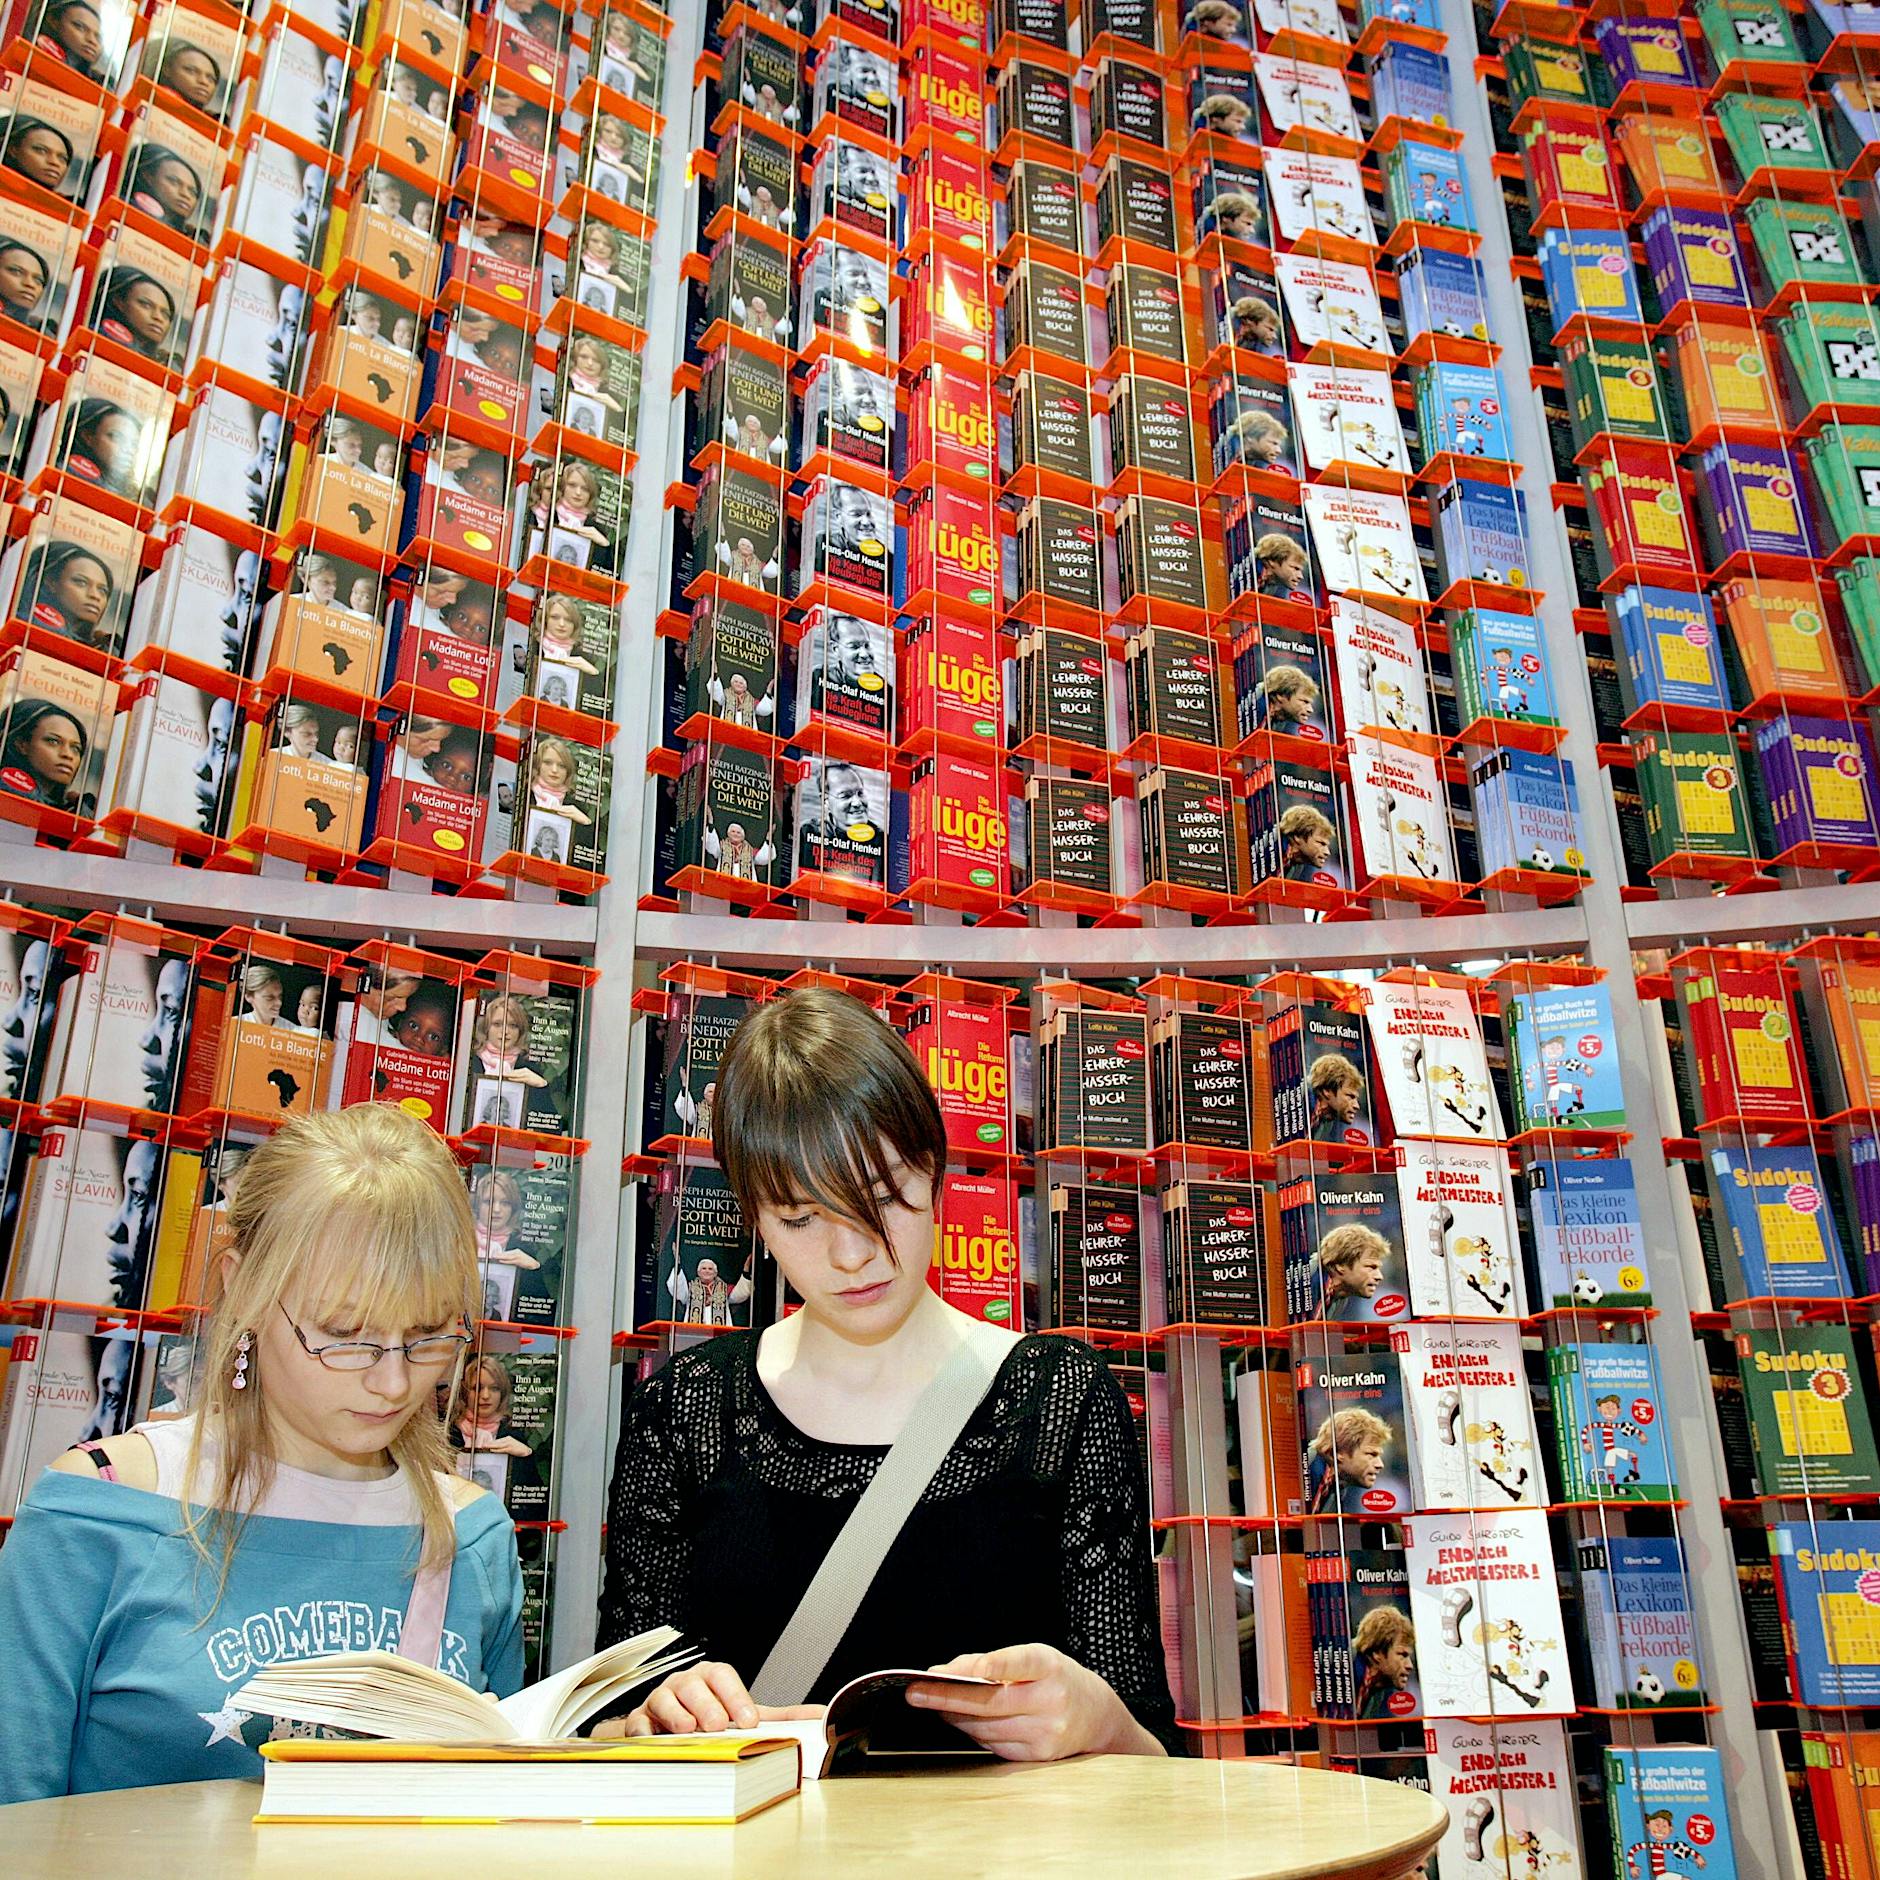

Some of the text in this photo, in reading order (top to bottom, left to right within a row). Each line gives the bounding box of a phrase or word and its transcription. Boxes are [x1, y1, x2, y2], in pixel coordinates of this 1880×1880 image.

[920, 73, 981, 119] lüge
[476, 256, 515, 276] Madame
[928, 396, 996, 447] lüge
[1257, 505, 1281, 519] Oliver
[1155, 524, 1170, 533] DAS
[1149, 535, 1189, 547] LEHRER-
[1151, 548, 1193, 560] HASSER-
[1159, 561, 1188, 572] BUCH
[23, 670, 110, 715] Feuerherz
[841, 695, 880, 715] Kraft des
[152, 716, 202, 742] SKLAVIN
[1659, 749, 1734, 768] Sudoku
[972, 769, 989, 780] Müller
[1373, 761, 1414, 781] ENDLICH
[1712, 769, 1726, 785] 3
[712, 780, 769, 802] GOTT UND
[1281, 774, 1330, 794] Oliver Kahn
[412, 791, 456, 812] Madame
[718, 791, 764, 811] DIE WELT
[978, 795, 989, 805] Die
[1184, 801, 1200, 809] DAS
[933, 795, 1006, 849] lüge
[1178, 812, 1221, 823] LEHRER-
[1180, 827, 1223, 839] HASSER-
[852, 842, 881, 856] Henkel
[1188, 843, 1219, 854] BUCH
[89, 992, 150, 1014] SKLAVIN
[947, 1009, 990, 1024] Albrecht Müller
[1394, 1008, 1445, 1021] ENDLICH
[1309, 1021, 1359, 1040] Oliver Kahn
[1771, 1018, 1784, 1036] 2
[240, 1031, 267, 1049] Lotti,
[271, 1038, 283, 1051] La
[978, 1042, 990, 1052] Die
[1087, 1045, 1105, 1055] DAS
[1200, 1047, 1217, 1057] DAS
[377, 1056, 450, 1081] Madame Lotti
[1193, 1060, 1239, 1073] LEHRER-
[928, 1047, 1006, 1103] lüge
[1194, 1077, 1242, 1090] HASSER-
[1089, 1091, 1125, 1106] BUCH
[1203, 1094, 1235, 1108] BUCH
[54, 1136, 63, 1155] Knaur
[547, 1155, 564, 1171] 20
[1426, 1171, 1480, 1185] ENDLICH
[1733, 1167, 1815, 1187] Sudoku
[54, 1178, 117, 1201] SKLAVIN
[951, 1183, 996, 1194] Albrecht Müller
[527, 1192, 552, 1202] Ihm in
[673, 1196, 730, 1211] BENEDIKT
[1320, 1190, 1384, 1205] Oliver Kahn
[1582, 1195, 1626, 1208] kleine
[524, 1210, 546, 1219] sehen
[525, 1201, 564, 1213] die Augen
[1326, 1206, 1381, 1216] Nummer eins
[680, 1210, 743, 1226] GOTT UND
[983, 1215, 996, 1225] Die
[1209, 1218, 1226, 1228] DAS
[1553, 1208, 1627, 1225] Lexikon
[686, 1223, 740, 1238] DIE WELT
[1202, 1230, 1251, 1246] LEHRER-
[1556, 1227, 1634, 1246] Fußball-
[932, 1224, 1016, 1281] lüge
[1204, 1247, 1254, 1263] HASSER-
[1560, 1248, 1634, 1265] rekorde
[1213, 1265, 1247, 1281] BUCH
[1213, 1291, 1227, 1299] Mutter
[1383, 1297, 1394, 1305] Der
[1376, 1301, 1404, 1315] Bestseller
[27, 1338, 35, 1359] Knaur
[1635, 1358, 1647, 1366] der
[1754, 1350, 1848, 1373] Sudoku
[515, 1375, 541, 1384] Ihm in
[1585, 1367, 1648, 1379] Fußballwitze
[514, 1384, 554, 1395] die Augen
[1820, 1373, 1840, 1396] 3
[26, 1384, 90, 1402] SKLAVIN
[514, 1394, 536, 1402] sehen
[1363, 1498, 1394, 1508] Bestseller
[1438, 1546, 1508, 1564] ENDLICH
[1356, 1569, 1384, 1583] Oliver
[1615, 1577, 1681, 1593] Das kleine
[1615, 1593, 1684, 1612] Lexikon
[1618, 1615, 1691, 1636] Fußball-
[206, 1600, 470, 1683] COMEBAK
[1620, 1638, 1691, 1658] rekorde
[1315, 1676, 1323, 1703] Oliver
[1460, 1753, 1526, 1772] ENDLICH
